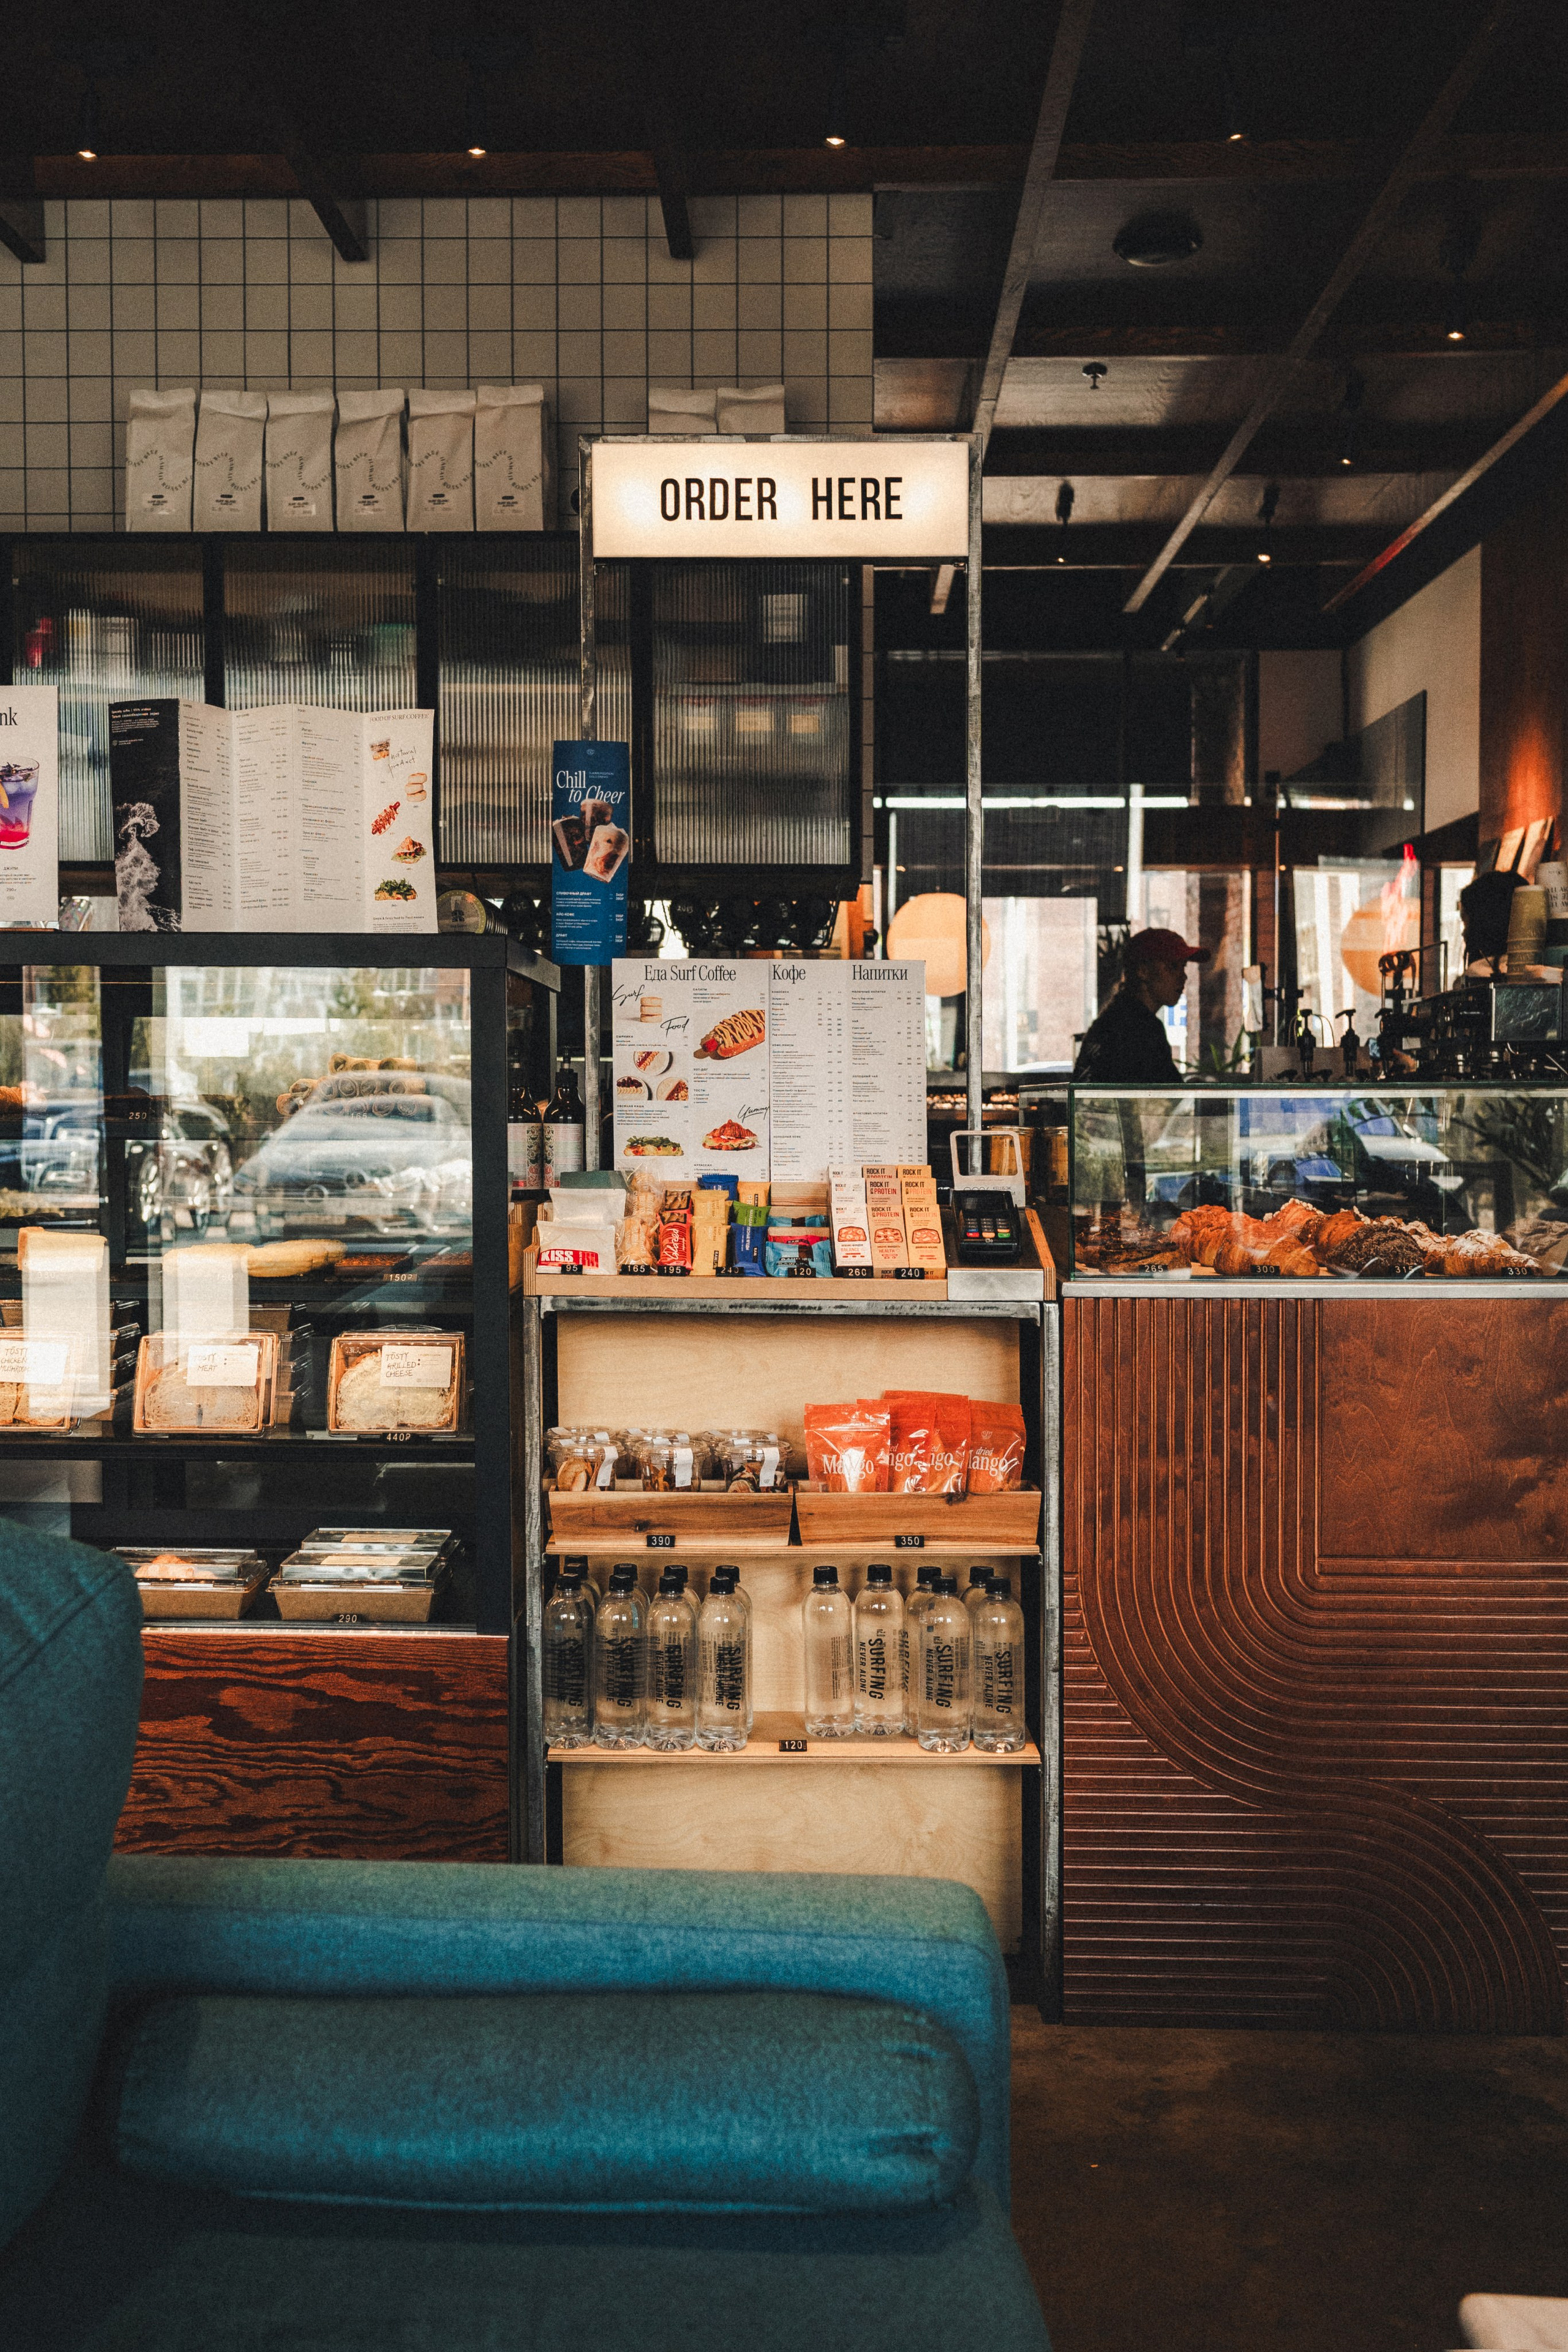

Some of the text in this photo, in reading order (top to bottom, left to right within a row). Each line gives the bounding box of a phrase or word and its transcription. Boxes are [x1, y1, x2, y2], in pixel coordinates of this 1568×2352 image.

[661, 477, 903, 521] ORDER HERE
[391, 745, 417, 760] natural
[556, 771, 586, 788] Chill
[568, 785, 625, 804] to Cheer
[644, 965, 736, 982] Еда Surf Coffee
[772, 965, 806, 984] Кофе
[852, 965, 908, 980] Напитки
[612, 984, 645, 1006] Surf
[660, 1016, 690, 1038] Food
[737, 1104, 770, 1123] Yummy
[663, 1228, 679, 1260] Glazed
[541, 1251, 574, 1262] KISS
[387, 1361, 417, 1370] GRILLED
[976, 1447, 994, 1457] dried
[822, 1453, 874, 1480] Mago
[651, 1536, 671, 1546] 390
[901, 1537, 919, 1546] 350
[339, 1615, 357, 1623] 290
[655, 1650, 664, 1703] NEVER ALONE
[666, 1646, 683, 1709] SURFING
[726, 1647, 742, 1710] SURFING
[868, 1638, 885, 1700] SURFING
[936, 1645, 952, 1709] SURFING
[984, 1656, 993, 1709] NEVER ALONE
[996, 1651, 1012, 1714] SURFING
